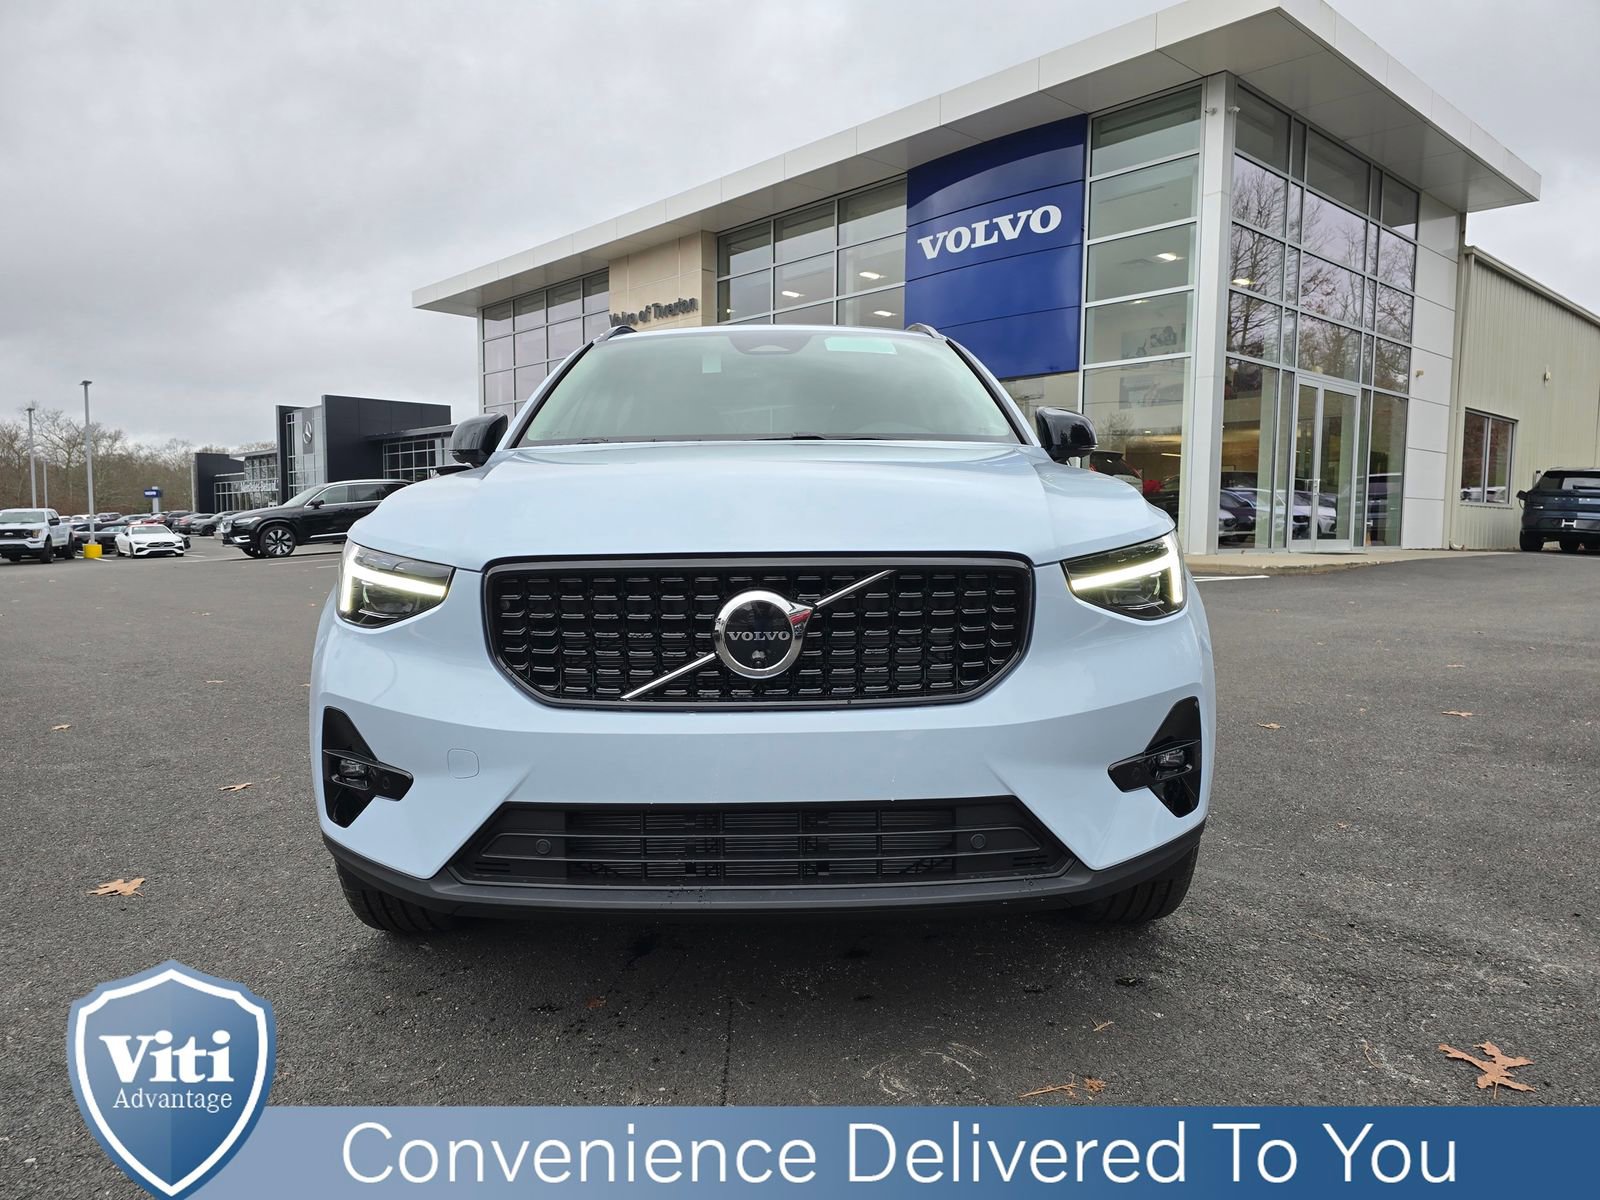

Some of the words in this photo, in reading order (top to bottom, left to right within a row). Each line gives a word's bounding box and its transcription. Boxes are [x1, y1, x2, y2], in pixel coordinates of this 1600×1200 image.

[917, 205, 1062, 260] VOLVO
[638, 305, 652, 323] of
[727, 631, 790, 640] VOLVO
